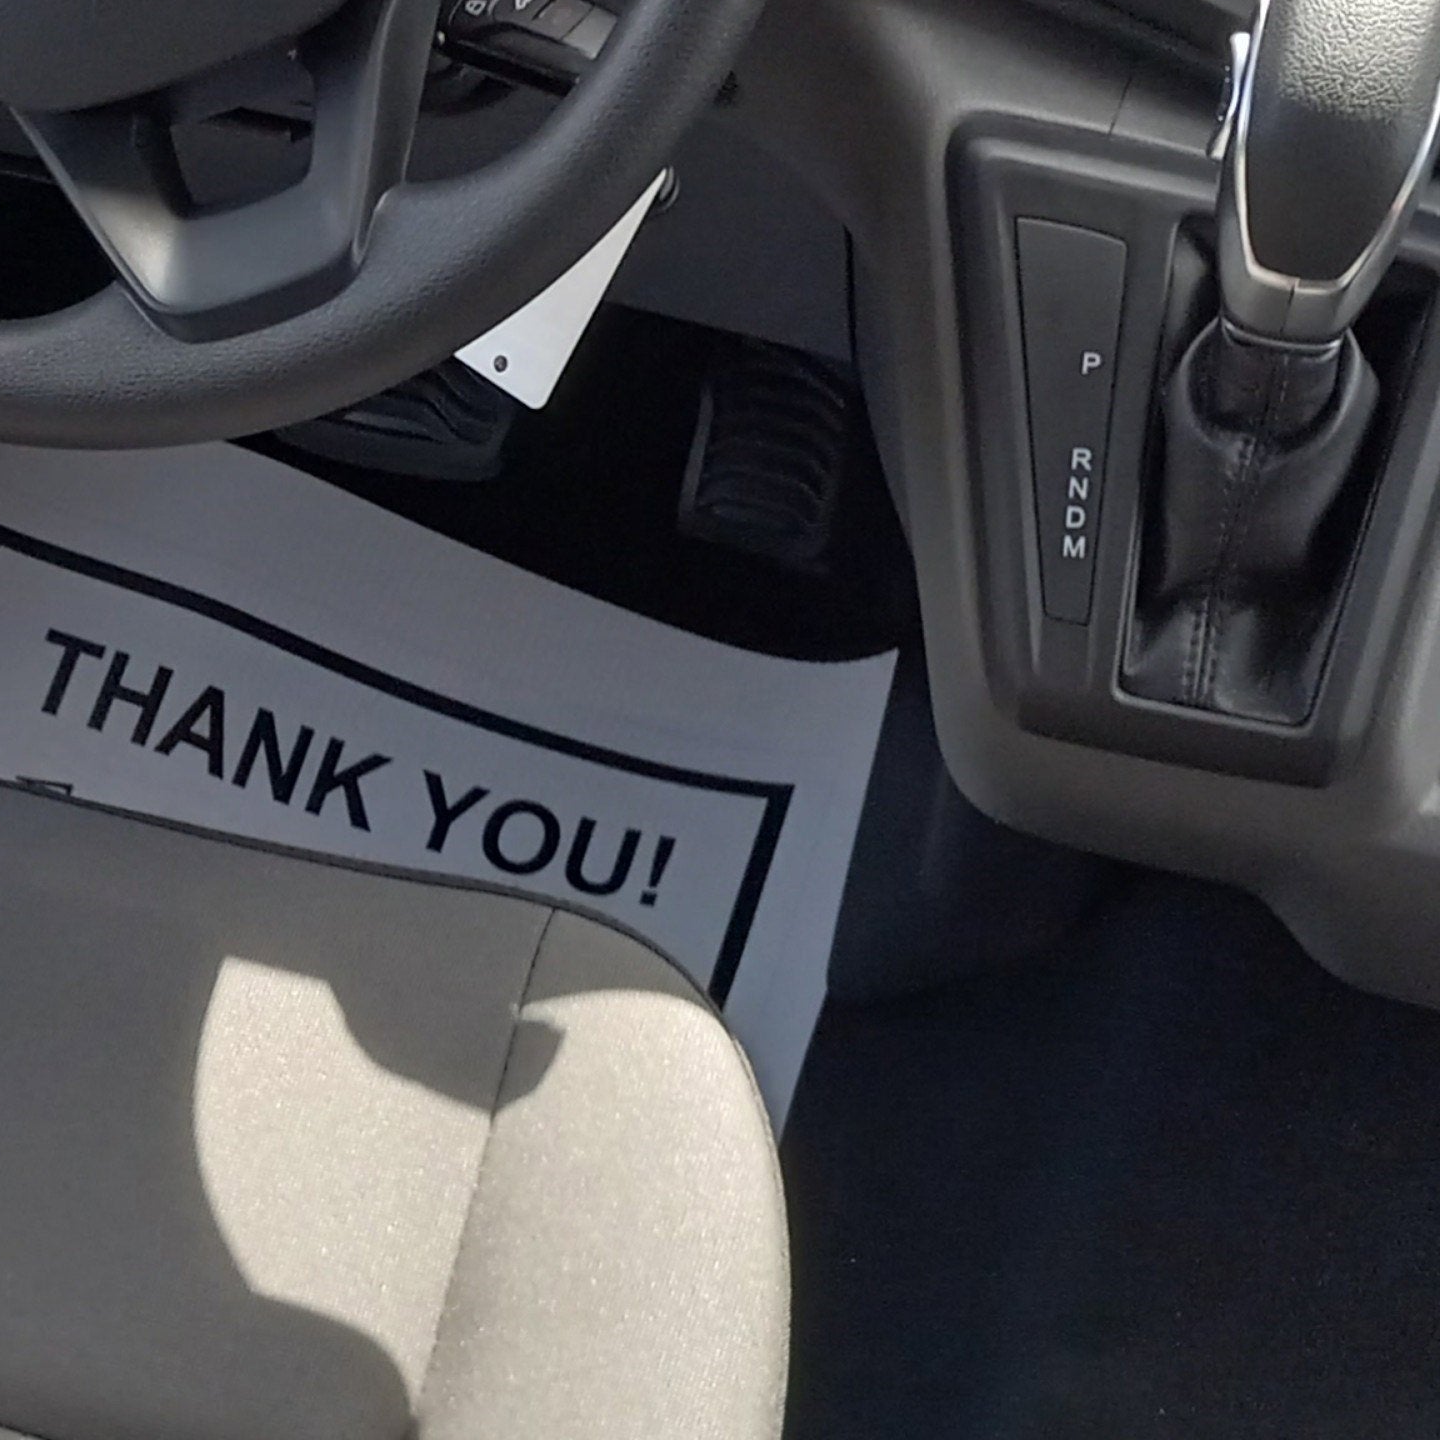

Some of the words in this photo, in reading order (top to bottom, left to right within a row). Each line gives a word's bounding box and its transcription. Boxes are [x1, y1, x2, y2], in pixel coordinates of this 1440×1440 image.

[1081, 351, 1102, 376] P
[1071, 447, 1093, 471] R
[1068, 476, 1089, 501] N
[1065, 505, 1086, 529] D
[1062, 534, 1086, 559] M
[40, 628, 394, 832] THANK
[420, 769, 678, 908] YOU!
